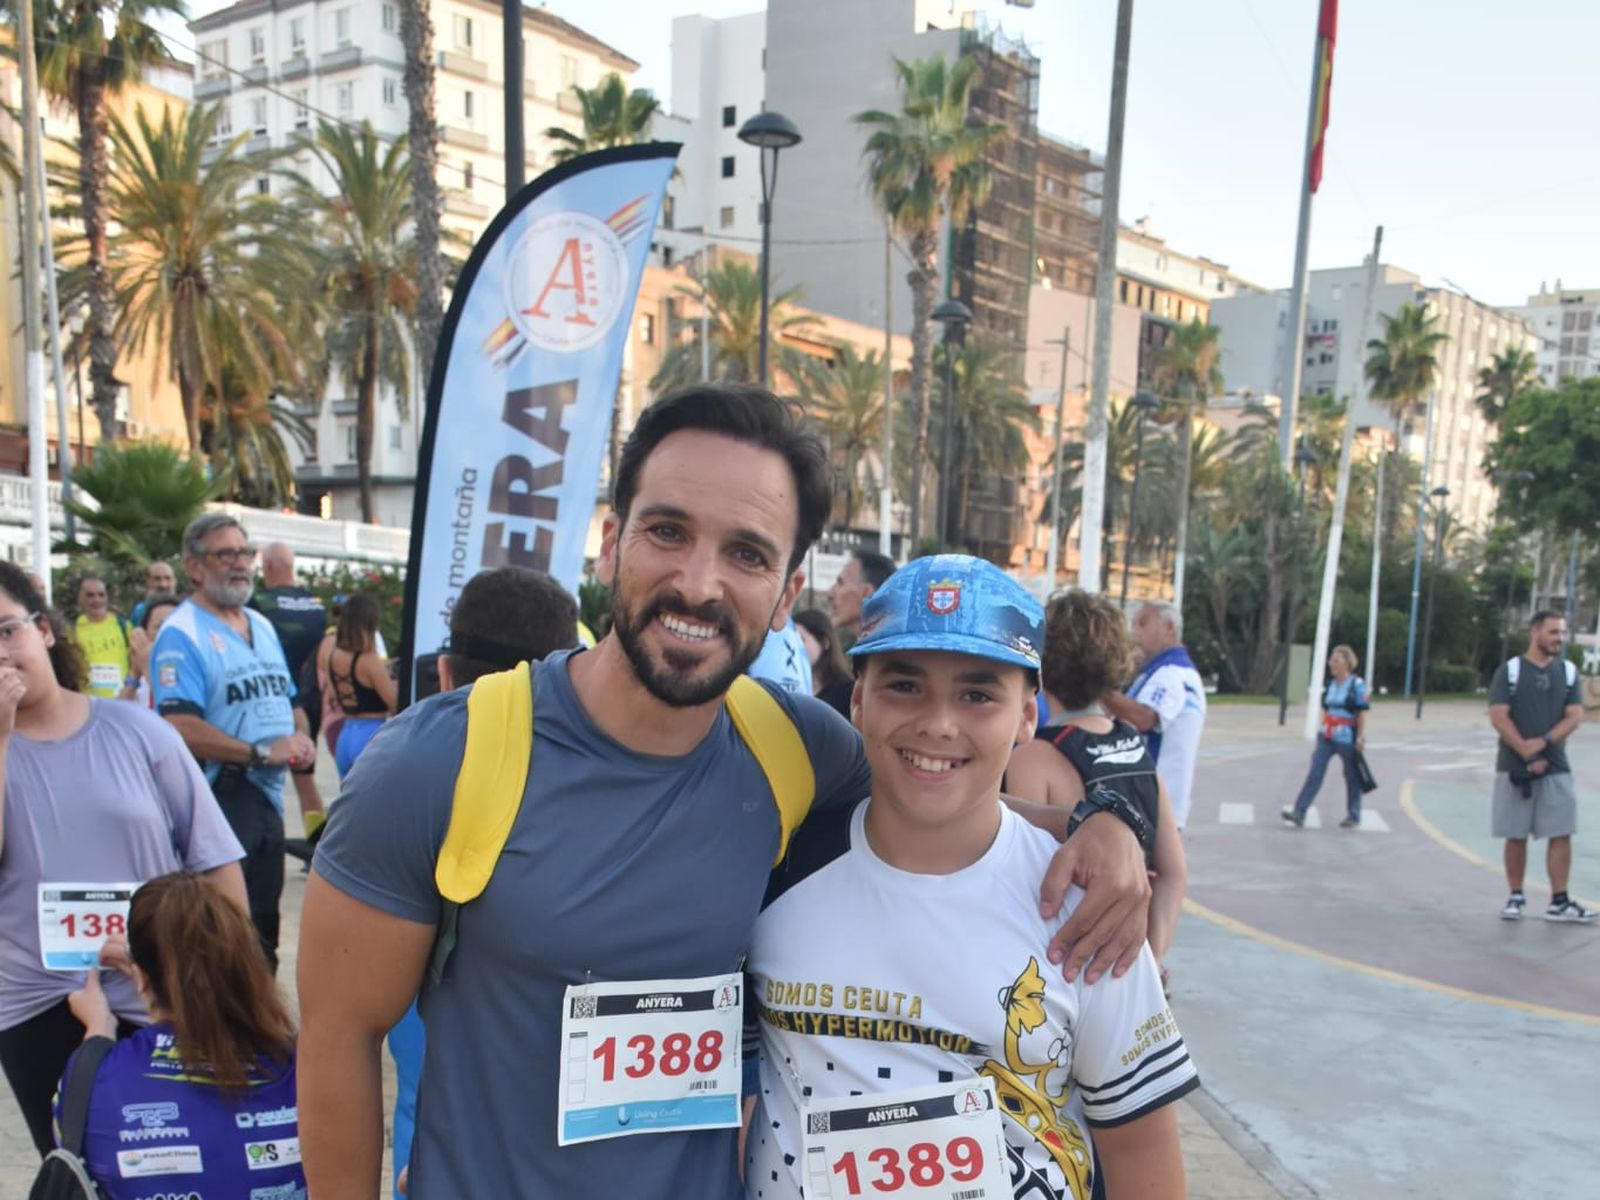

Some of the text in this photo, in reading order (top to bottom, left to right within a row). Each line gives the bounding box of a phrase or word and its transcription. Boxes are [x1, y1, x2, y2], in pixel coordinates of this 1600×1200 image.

[449, 467, 478, 588] montaña
[60, 912, 125, 938] 138
[635, 996, 684, 1009] ANYERA
[766, 980, 923, 1019] SOMOS CEUTA
[793, 1012, 972, 1054] HYPERMOTION
[1134, 1012, 1165, 1041] SOMOS
[593, 1030, 724, 1082] 1388
[867, 1106, 919, 1123] ANYERA
[832, 1136, 985, 1195] 1389
